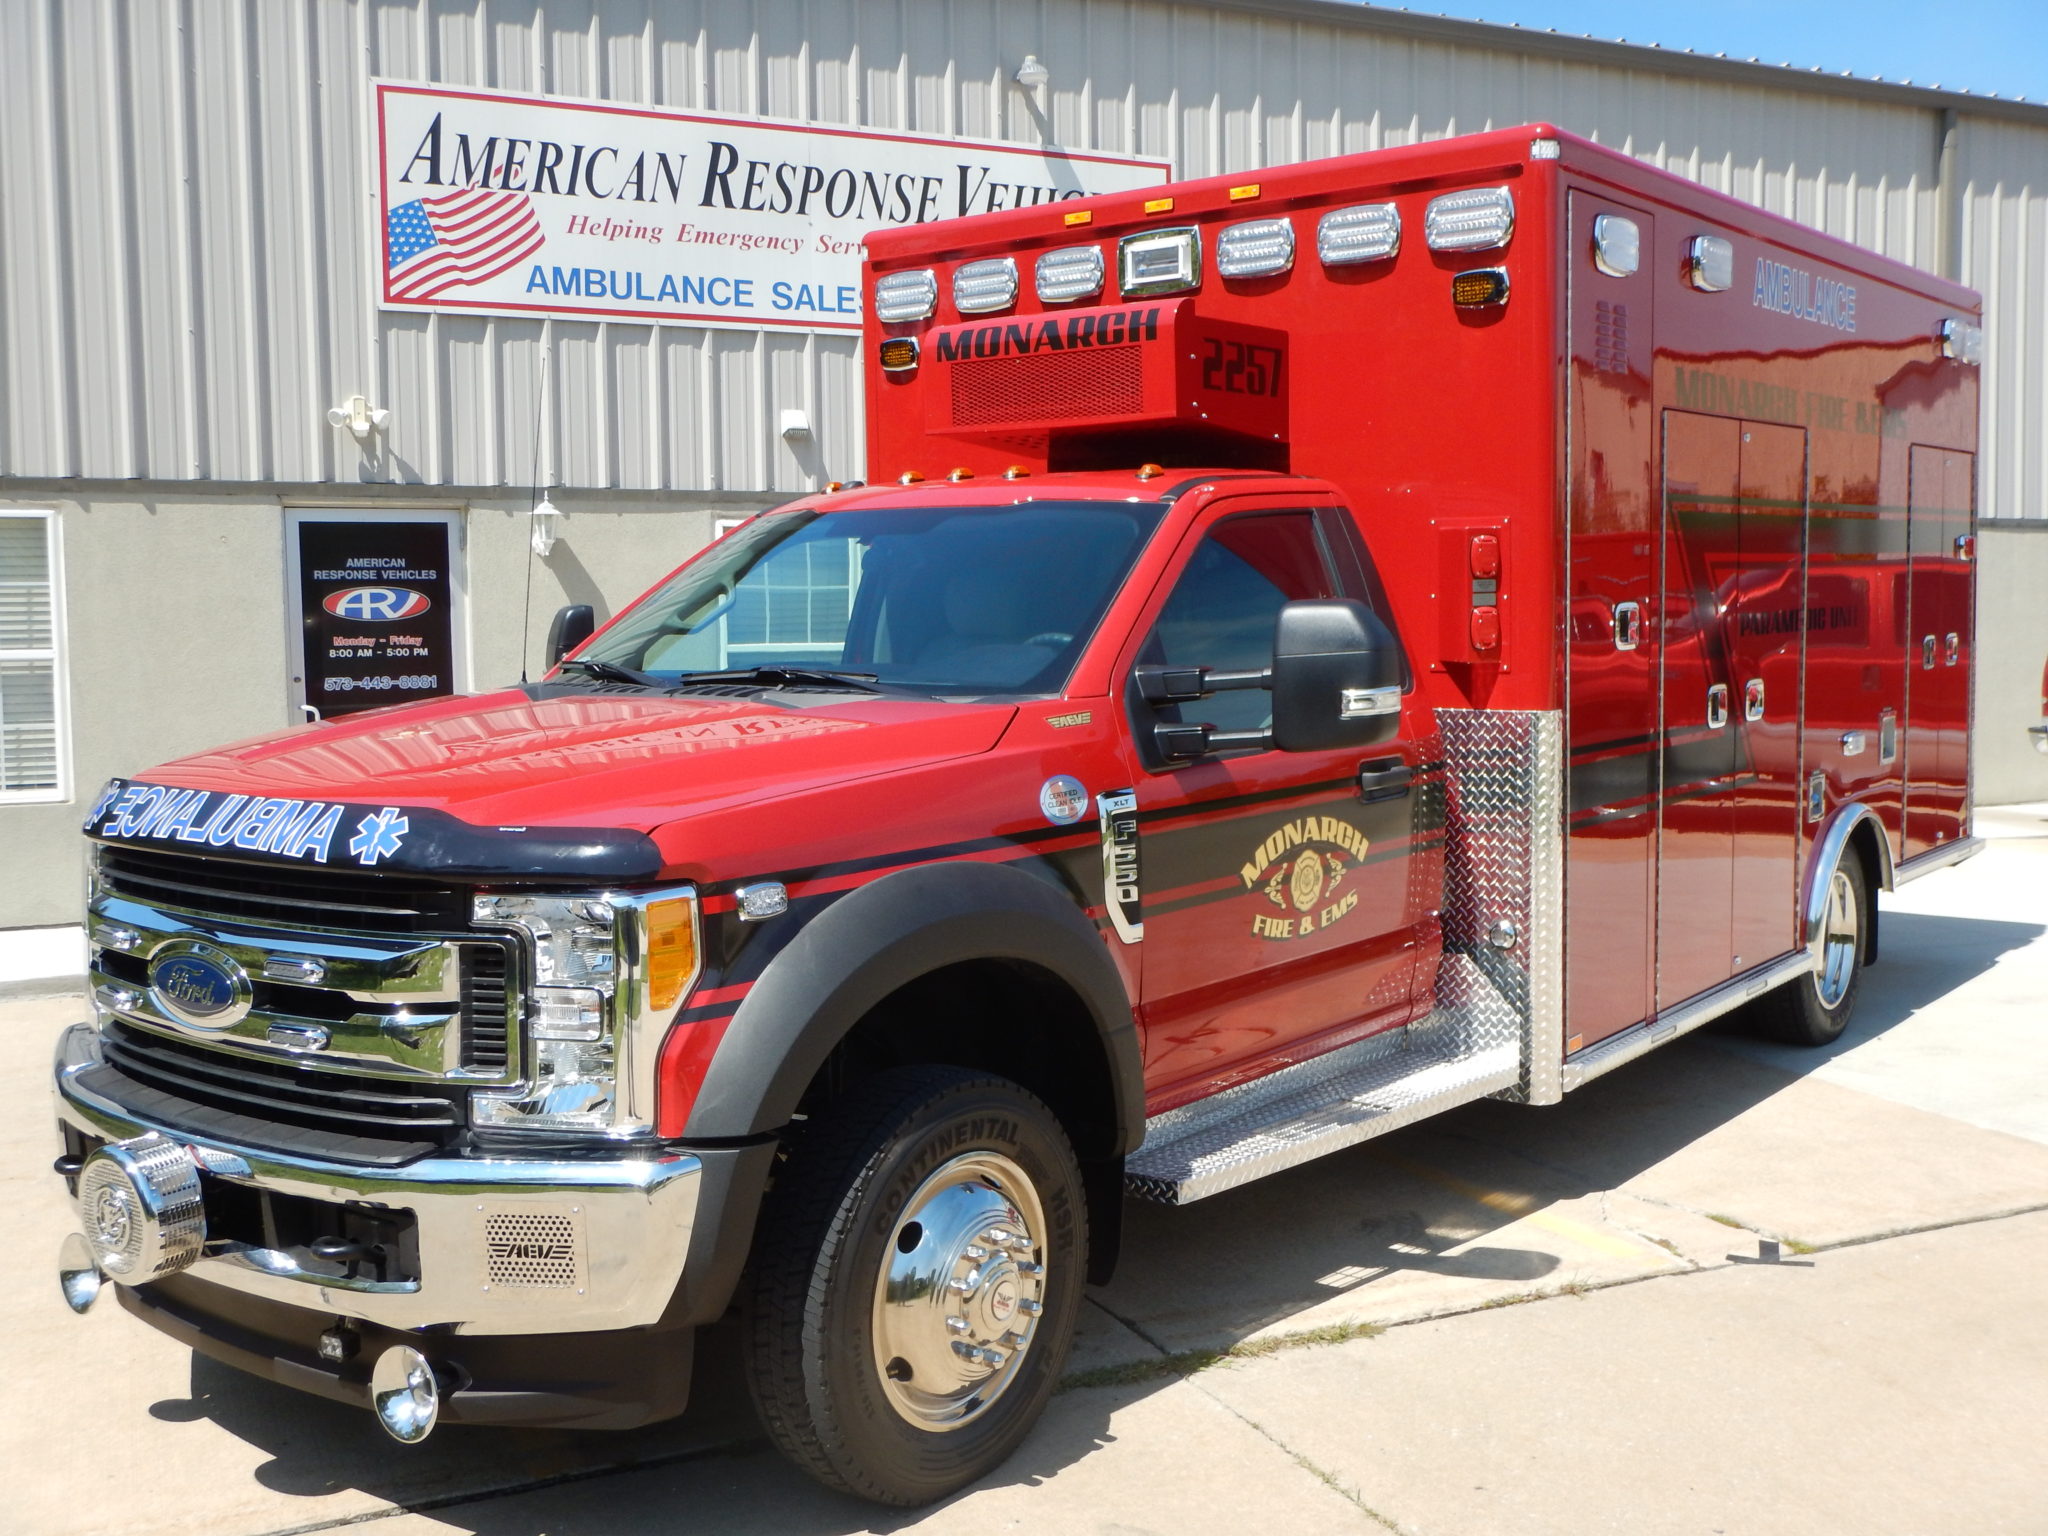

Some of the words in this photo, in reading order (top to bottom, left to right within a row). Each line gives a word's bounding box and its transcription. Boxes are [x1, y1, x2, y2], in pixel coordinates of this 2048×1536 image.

[399, 111, 688, 205] AMERICAN
[697, 141, 943, 224] RESPONSE
[566, 214, 664, 245] Helping
[676, 223, 805, 255] Emergency
[525, 265, 754, 308] AMBULANCE
[771, 281, 863, 314] SALE
[1753, 256, 1856, 333] AMBULANCE
[936, 308, 1161, 363] MONARCH
[1202, 337, 1283, 398] 2257
[1674, 366, 1799, 425] MONARCH
[1804, 390, 1849, 432] FIRE
[314, 570, 377, 580] RESPONSE
[382, 570, 437, 580] VEHICLES
[346, 558, 406, 568] AMERICAN
[329, 649, 353, 658] 8:00
[357, 649, 373, 657] AM
[386, 648, 409, 657] 5:00
[413, 648, 429, 656] PM
[333, 636, 376, 647] Monday
[389, 635, 423, 646] Friday
[323, 675, 438, 692] 573-443-8881
[1048, 789, 1078, 800] CERTIFIED
[1048, 799, 1068, 808] CLEAN
[1113, 799, 1130, 807] XLT
[1240, 816, 1369, 889] MONARCH
[1252, 914, 1295, 938] FIRE
[1299, 915, 1315, 936] &
[1321, 888, 1358, 928] EMS
[167, 964, 215, 1006] Ford
[874, 1118, 1020, 1235] CONTINENTAL
